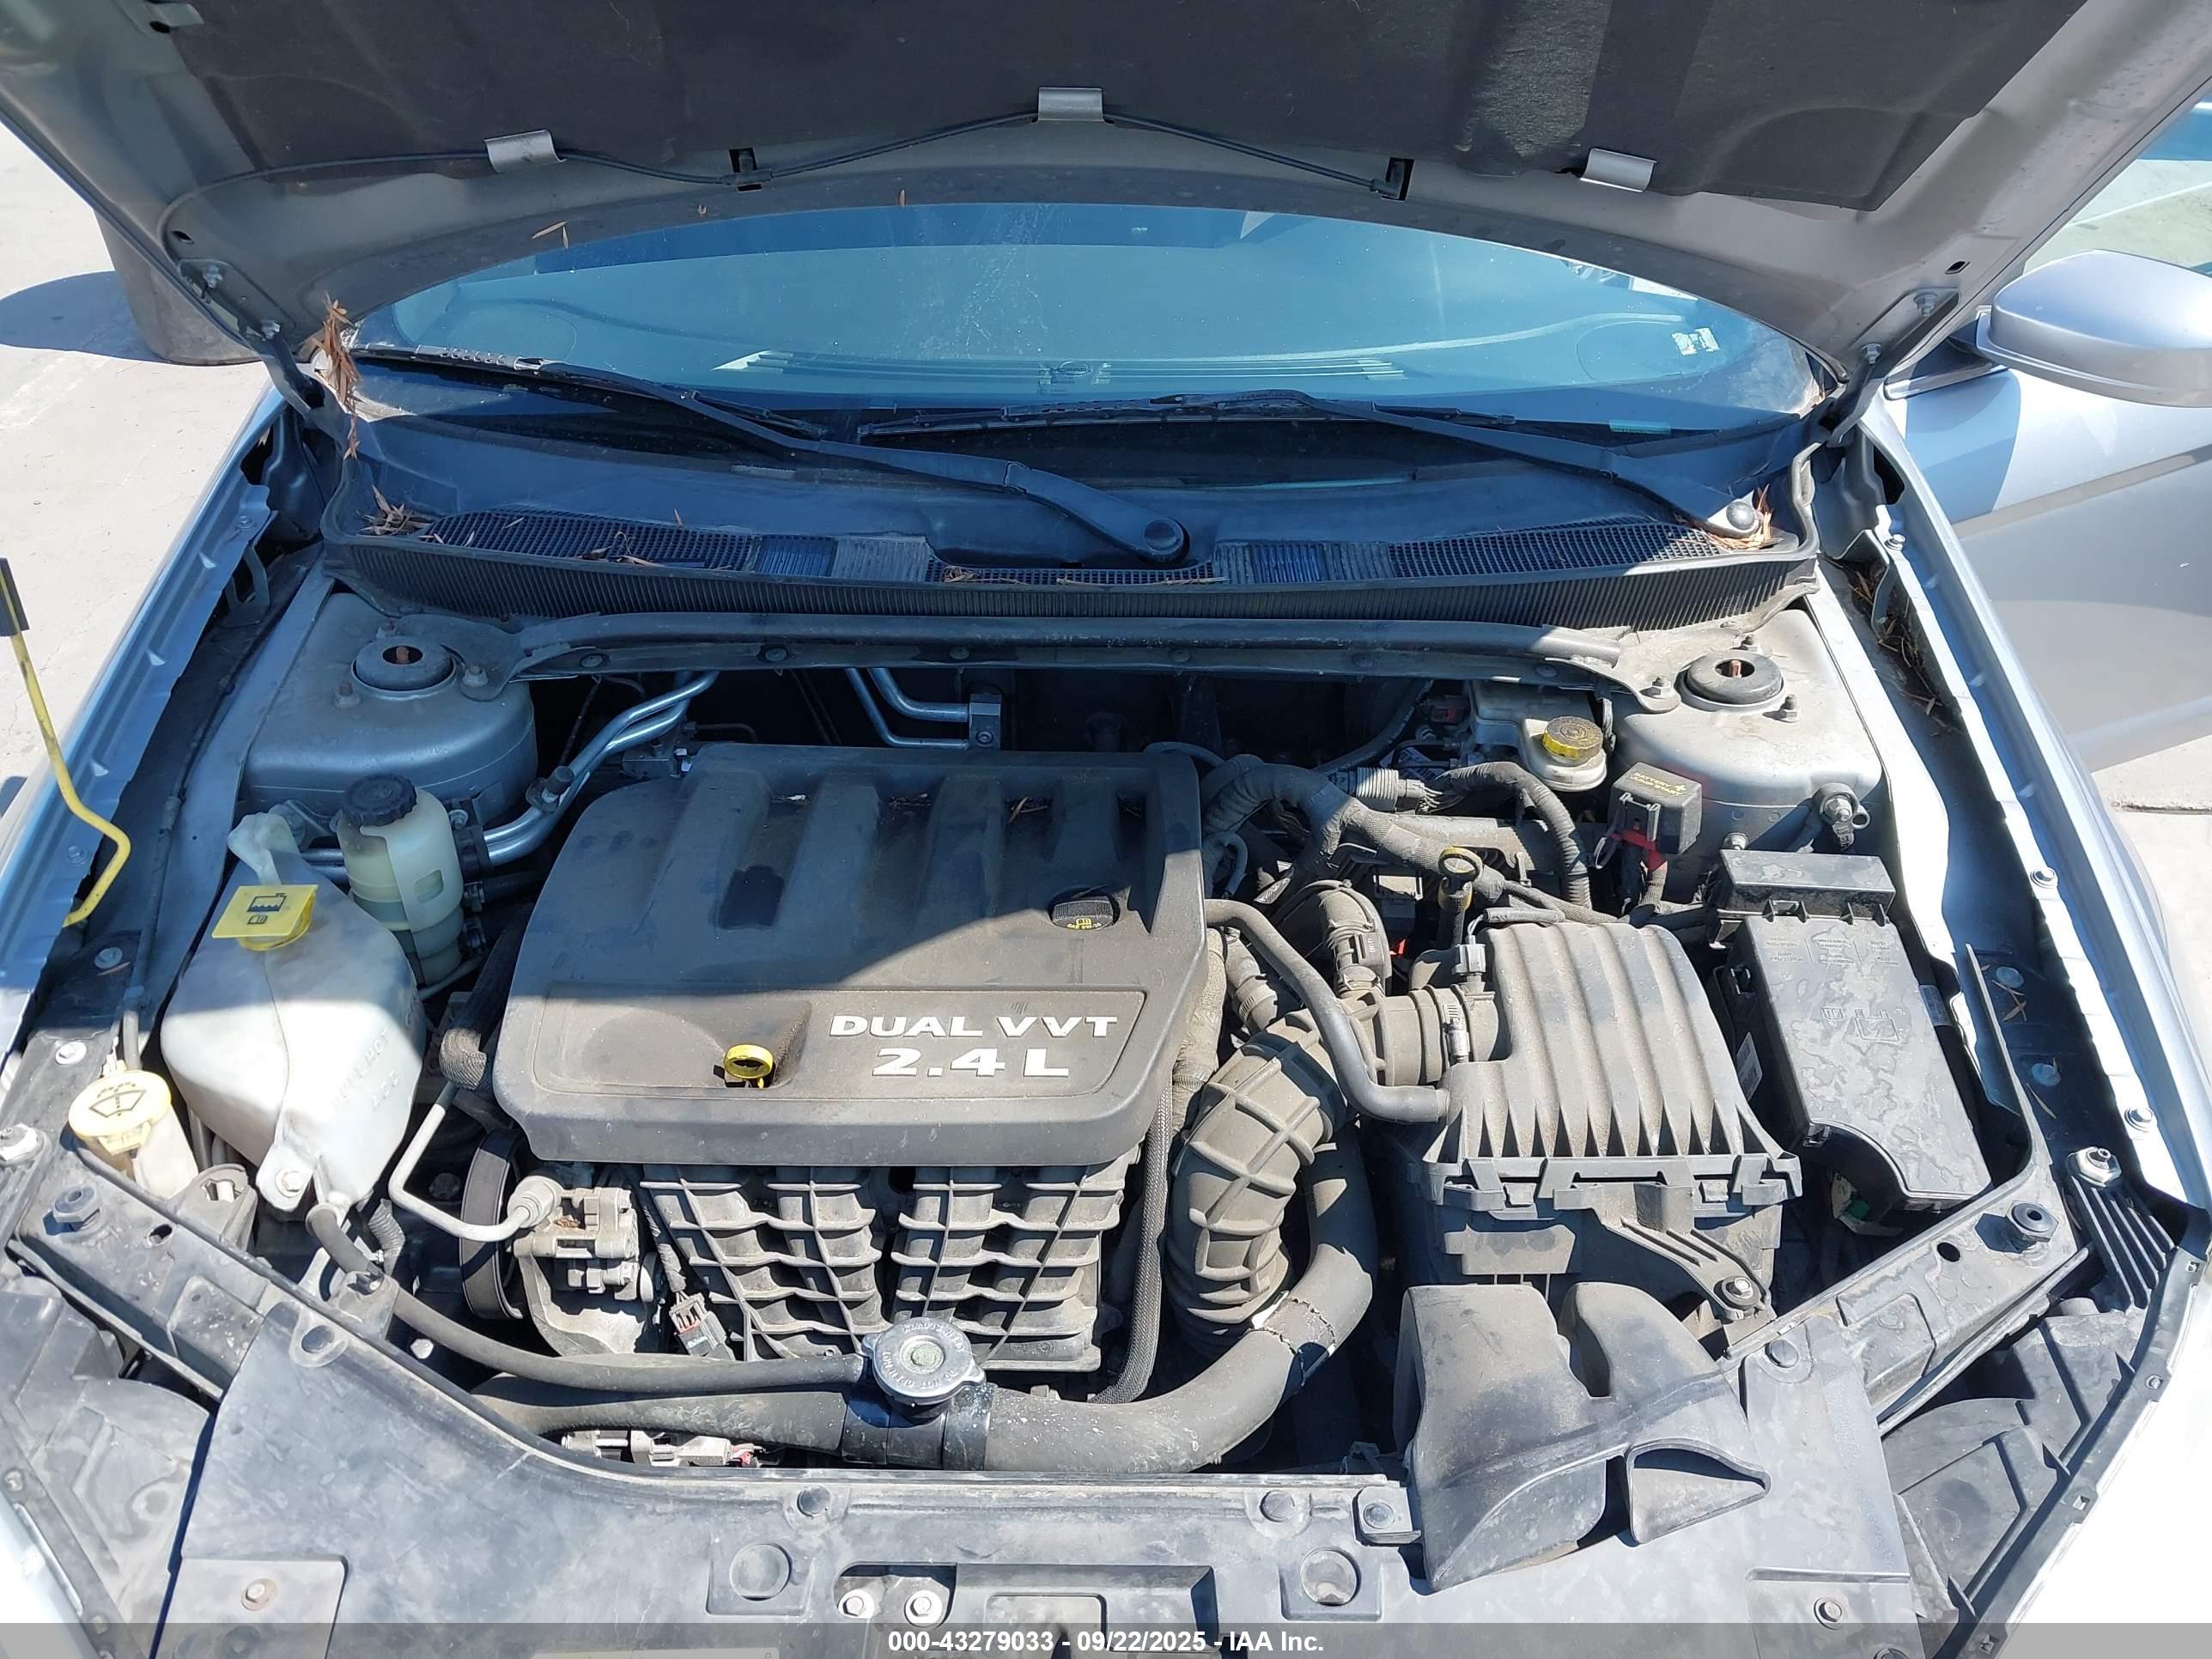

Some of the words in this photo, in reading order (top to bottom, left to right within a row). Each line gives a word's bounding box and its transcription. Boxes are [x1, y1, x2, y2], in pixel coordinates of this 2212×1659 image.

[1633, 772, 1672, 787] BATTERY
[830, 1015, 983, 1036] DUAL
[997, 1016, 1118, 1037] VVT
